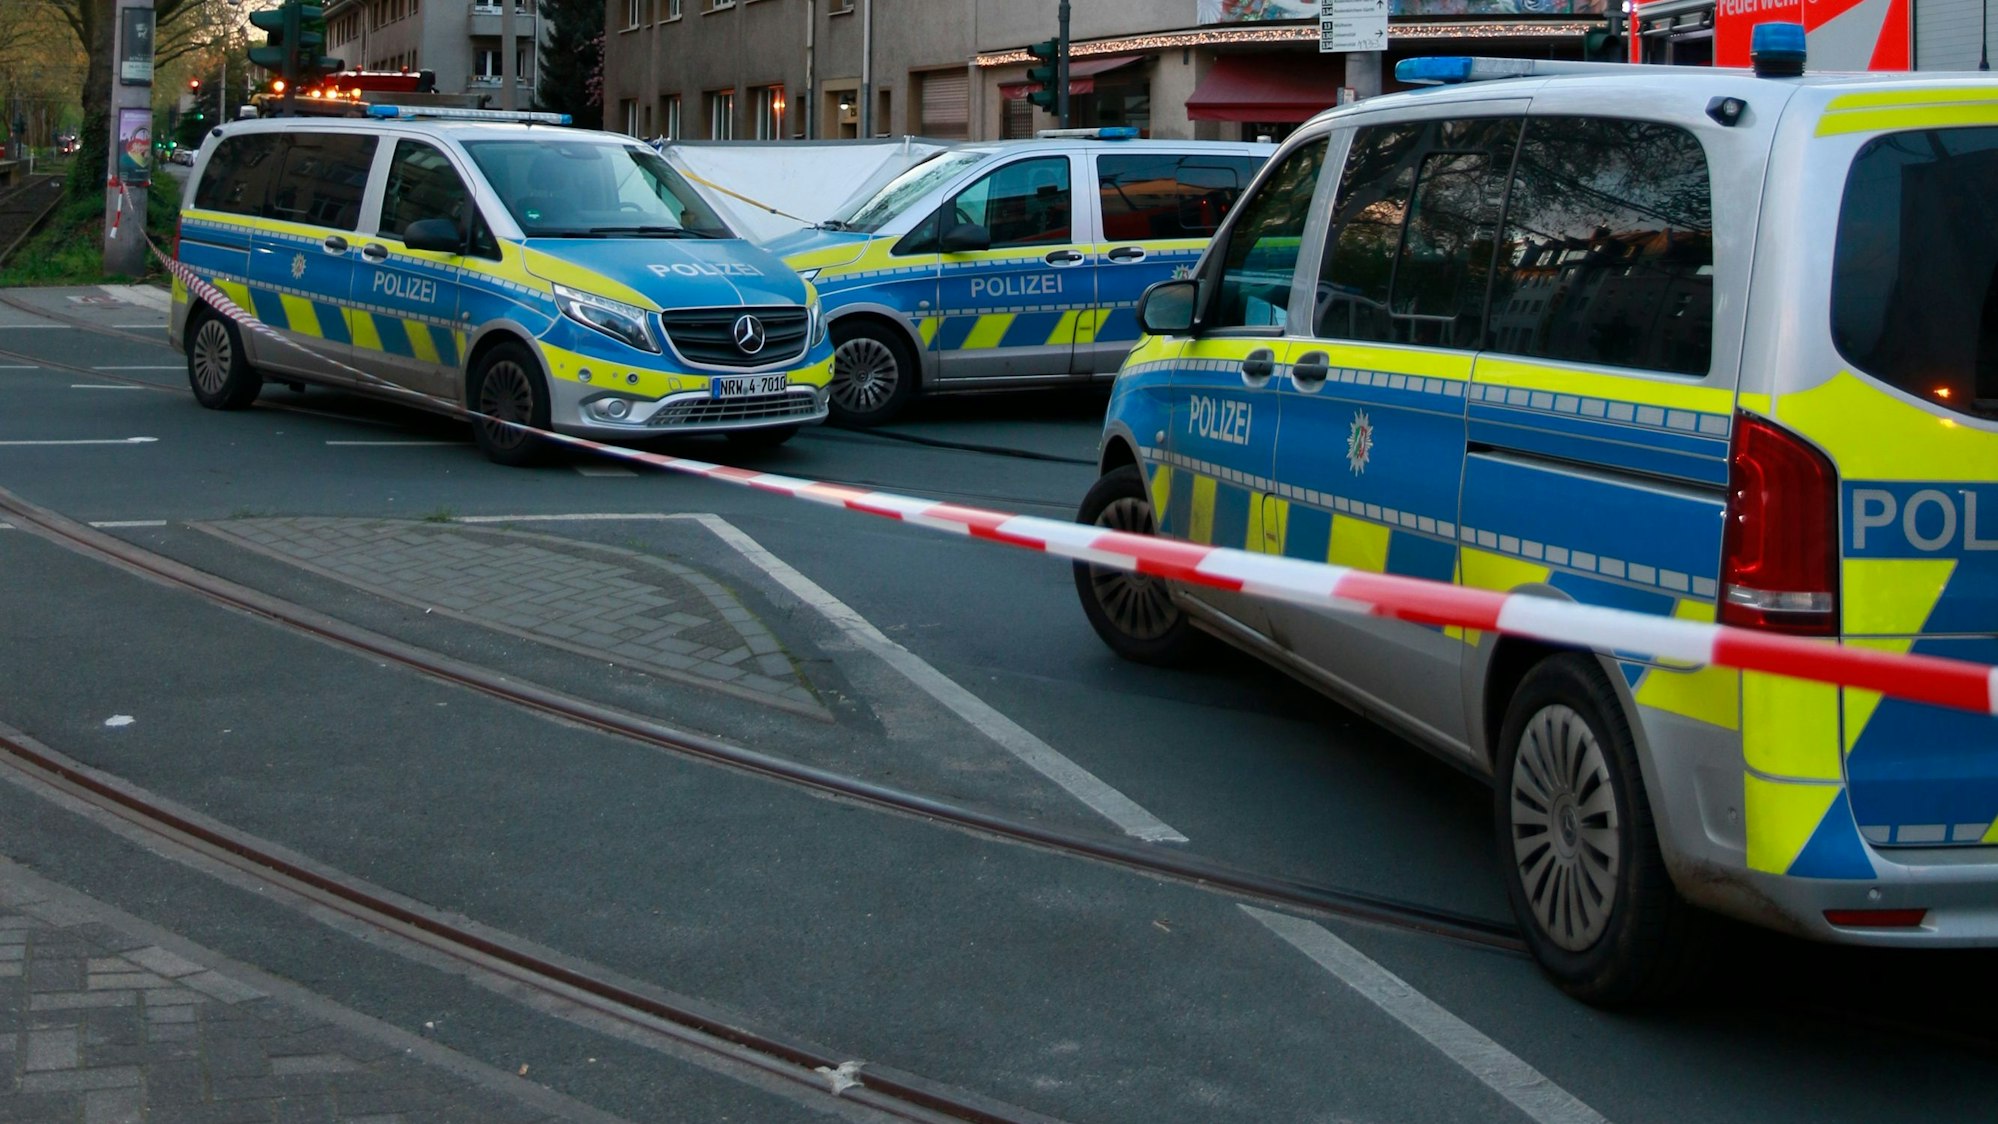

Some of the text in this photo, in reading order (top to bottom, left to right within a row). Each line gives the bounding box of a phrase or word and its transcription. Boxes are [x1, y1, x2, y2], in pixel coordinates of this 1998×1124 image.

[646, 263, 765, 278] POLIZEI
[373, 270, 437, 303] POLIZEI
[971, 273, 1063, 298] POLIZEI
[720, 376, 786, 395] NRW 4-7010
[1188, 394, 1252, 446] POLIZEI
[1852, 488, 1998, 551] POL
